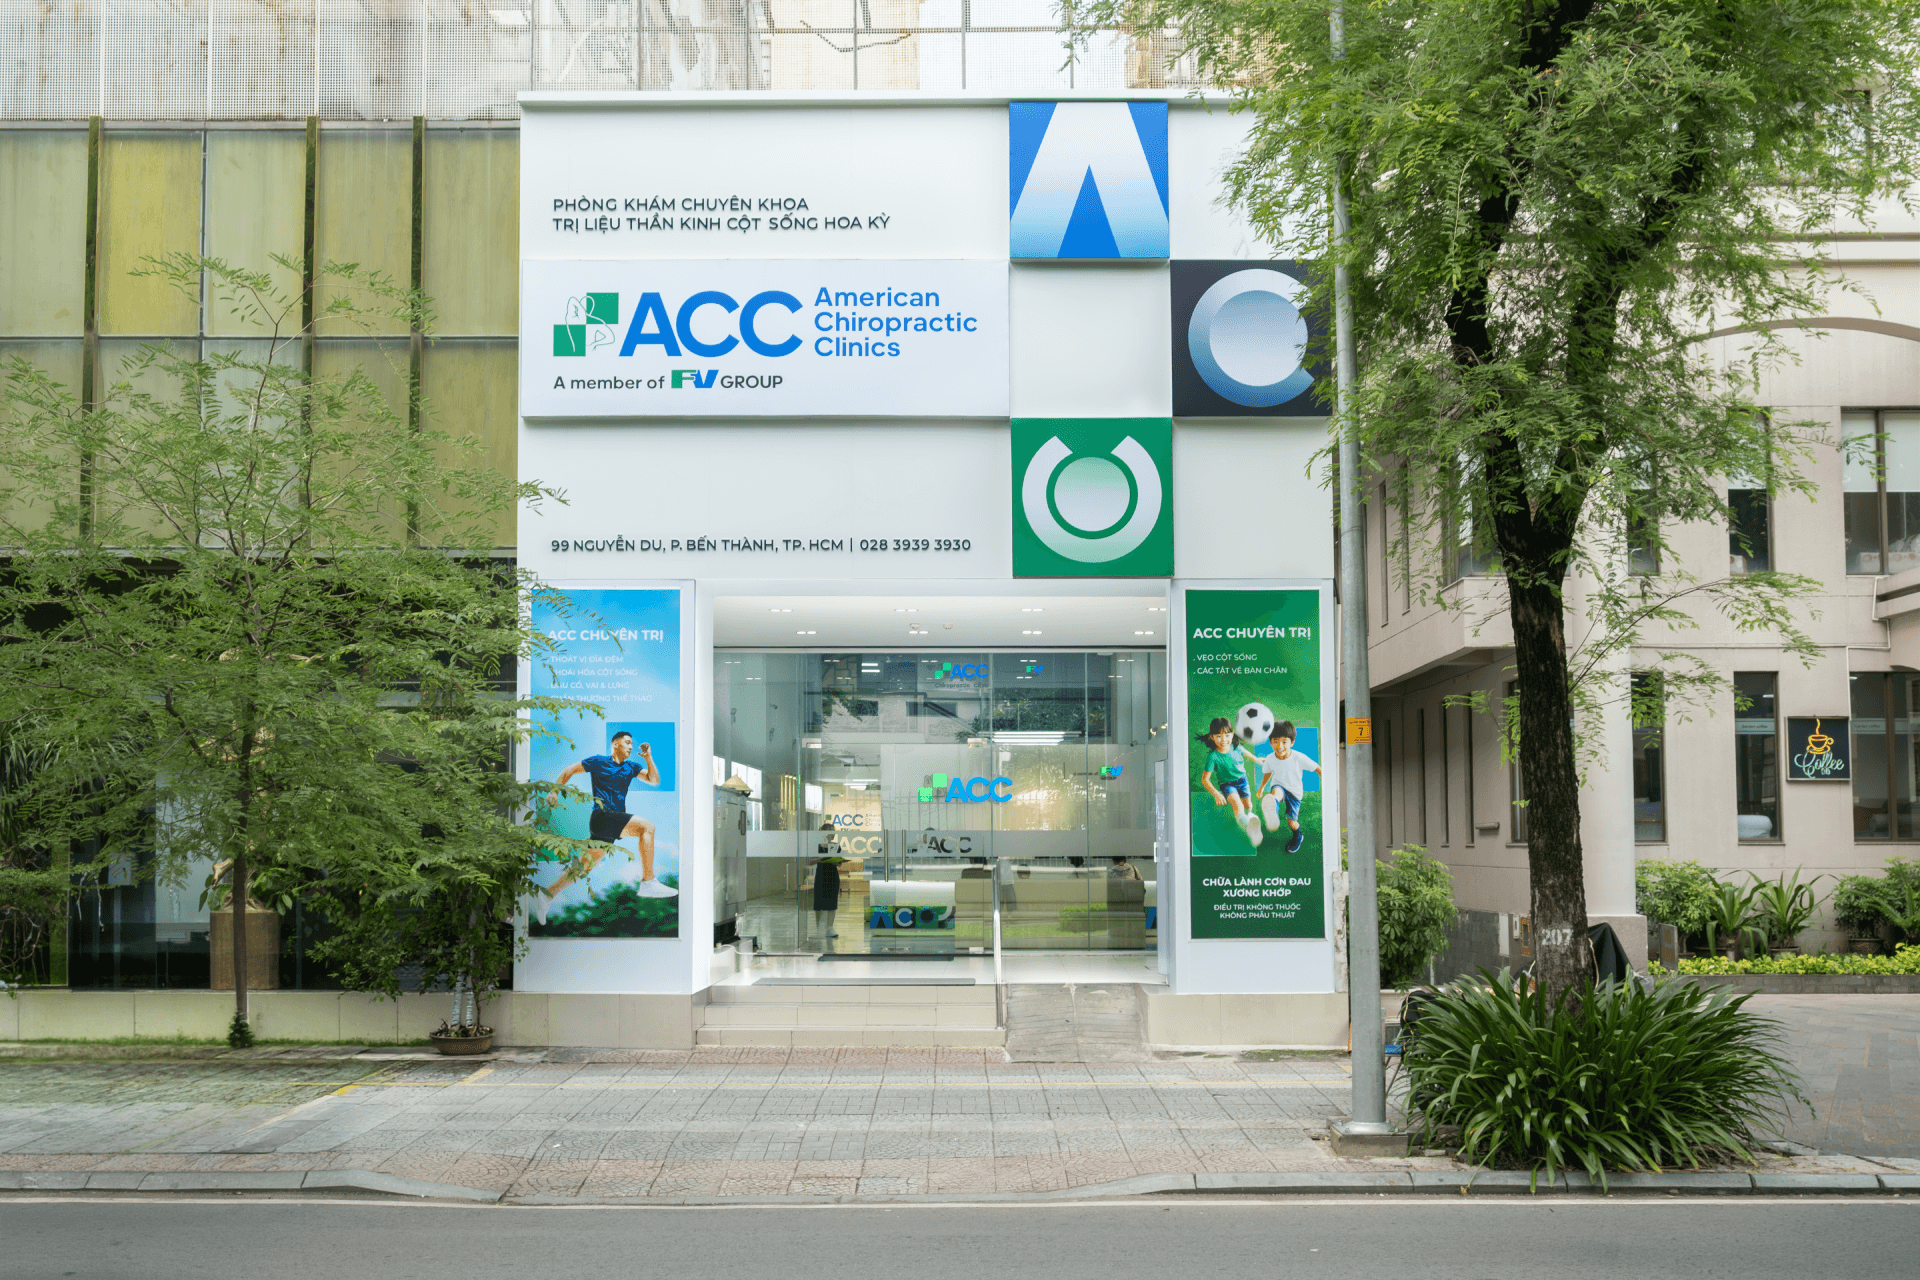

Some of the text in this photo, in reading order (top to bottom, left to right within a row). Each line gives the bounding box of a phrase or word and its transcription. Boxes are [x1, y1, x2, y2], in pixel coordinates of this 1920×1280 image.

[553, 195, 809, 211] PHÒNG KHÁM CHUYÊN KHOA
[553, 212, 890, 234] TRỊ LIỆU THẦN KINH CỘT SỐNG HOA KỲ
[814, 287, 940, 307] American
[618, 290, 803, 357] ACC
[814, 311, 978, 337] Chiropractic
[814, 336, 901, 357] Clinics
[553, 376, 565, 389] A
[570, 376, 642, 389] member
[647, 376, 665, 389] of
[720, 375, 783, 389] GROUP
[551, 539, 570, 551] 99
[573, 534, 635, 551] NGUYỄN
[640, 539, 666, 553] DU,
[671, 539, 683, 551] P.
[686, 535, 717, 551] BẾN
[721, 537, 779, 553] THÀNH,
[782, 539, 805, 551] TP.
[809, 539, 843, 550] HCM
[859, 539, 888, 551] 028
[893, 539, 930, 551] 3939
[934, 539, 971, 551] 3930
[548, 627, 664, 643] ACC CHUYÊN TRỊ
[1193, 625, 1311, 640] ACC CHUYÊN TRỊ
[550, 655, 578, 663] THOÁT
[1215, 653, 1232, 662] CỘT
[1234, 652, 1258, 661] SỐNG
[949, 663, 989, 679] ACC
[1197, 666, 1214, 674] CÁC
[1263, 666, 1288, 674] CHÂN
[1793, 749, 1845, 779] Coffee
[945, 776, 1013, 803] ACC
[832, 814, 864, 826] ACC
[837, 836, 883, 854] ACC
[1202, 876, 1311, 886] CHỮA LÀNH CƠN ĐAU
[1223, 887, 1292, 897] XƯƠNG KHỚP
[1541, 928, 1574, 946] 207
